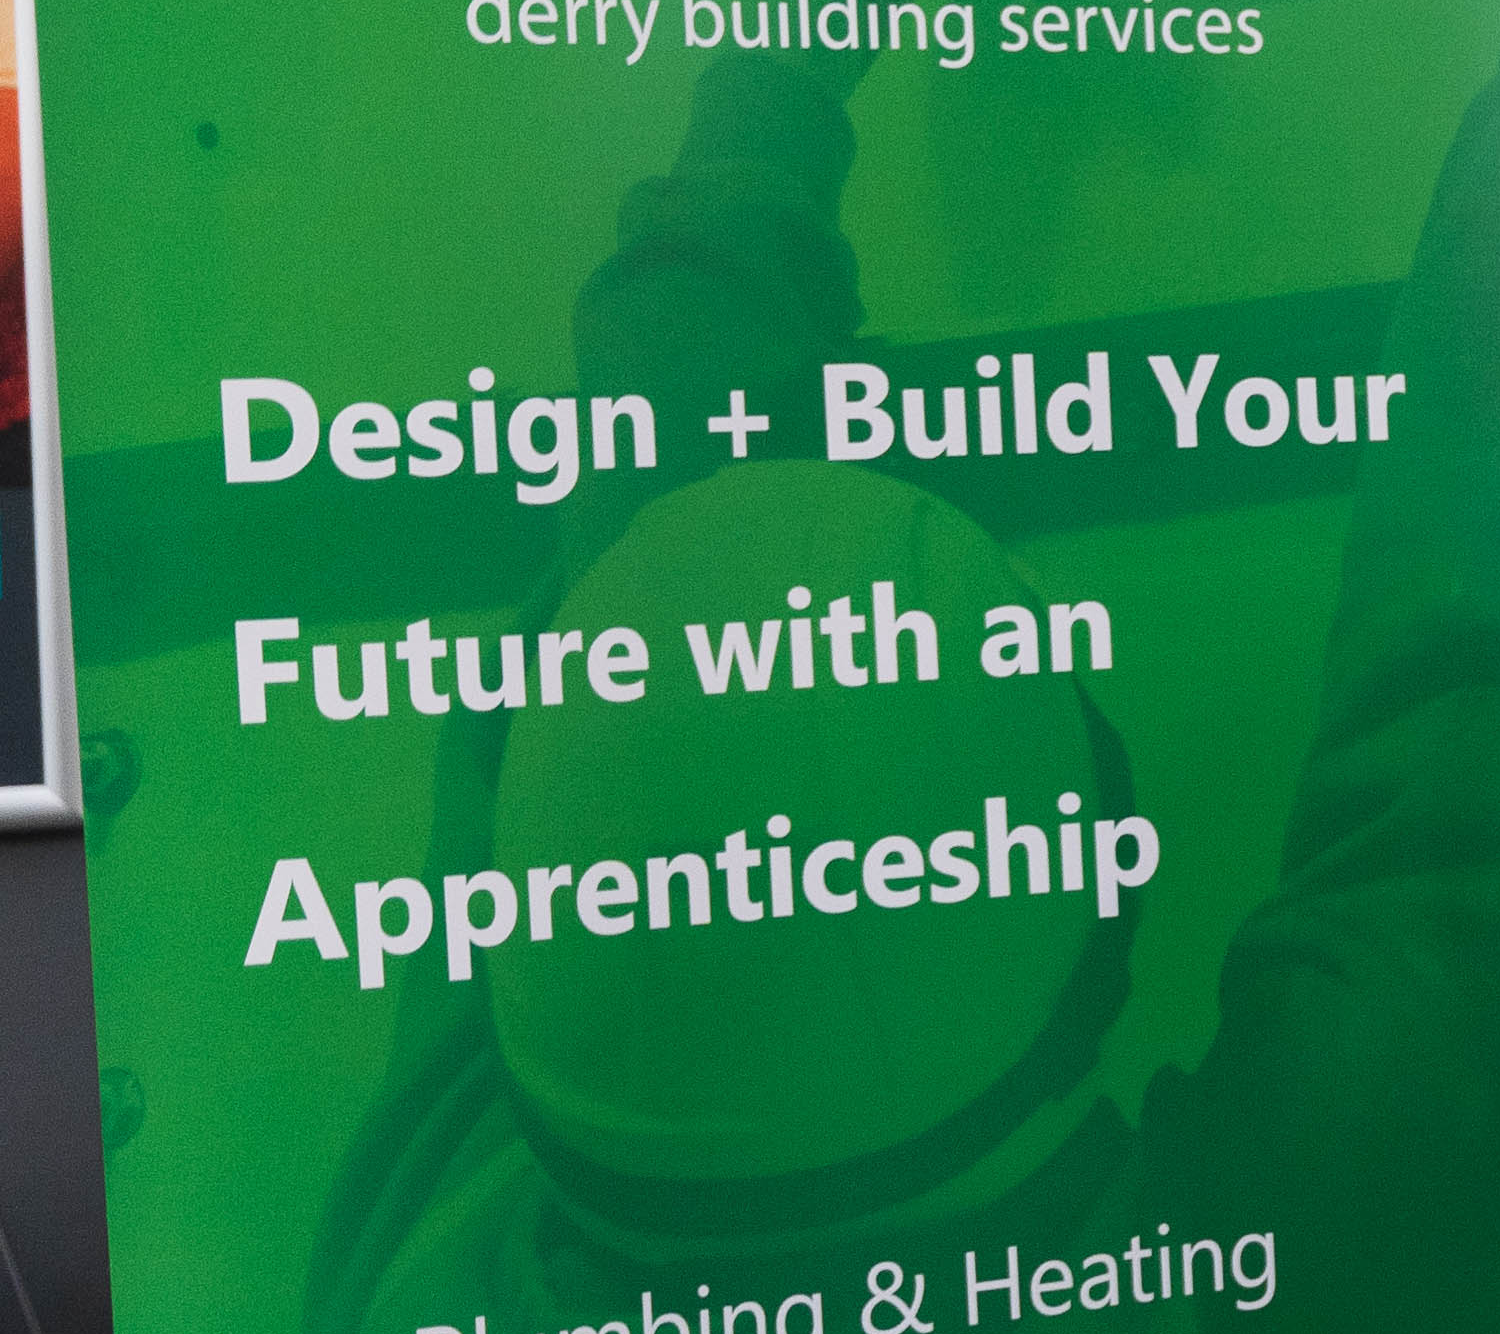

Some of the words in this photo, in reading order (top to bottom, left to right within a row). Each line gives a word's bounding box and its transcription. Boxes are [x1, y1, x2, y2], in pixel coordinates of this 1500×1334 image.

[220, 367, 656, 504] Design
[708, 390, 769, 457] +
[823, 352, 1112, 461] Build
[1148, 354, 1406, 448] Your
[235, 618, 649, 725] Future
[685, 581, 939, 694] with
[981, 601, 1112, 671] an
[244, 792, 1159, 989] Apprenticeship
[966, 1223, 1275, 1325] Heating
